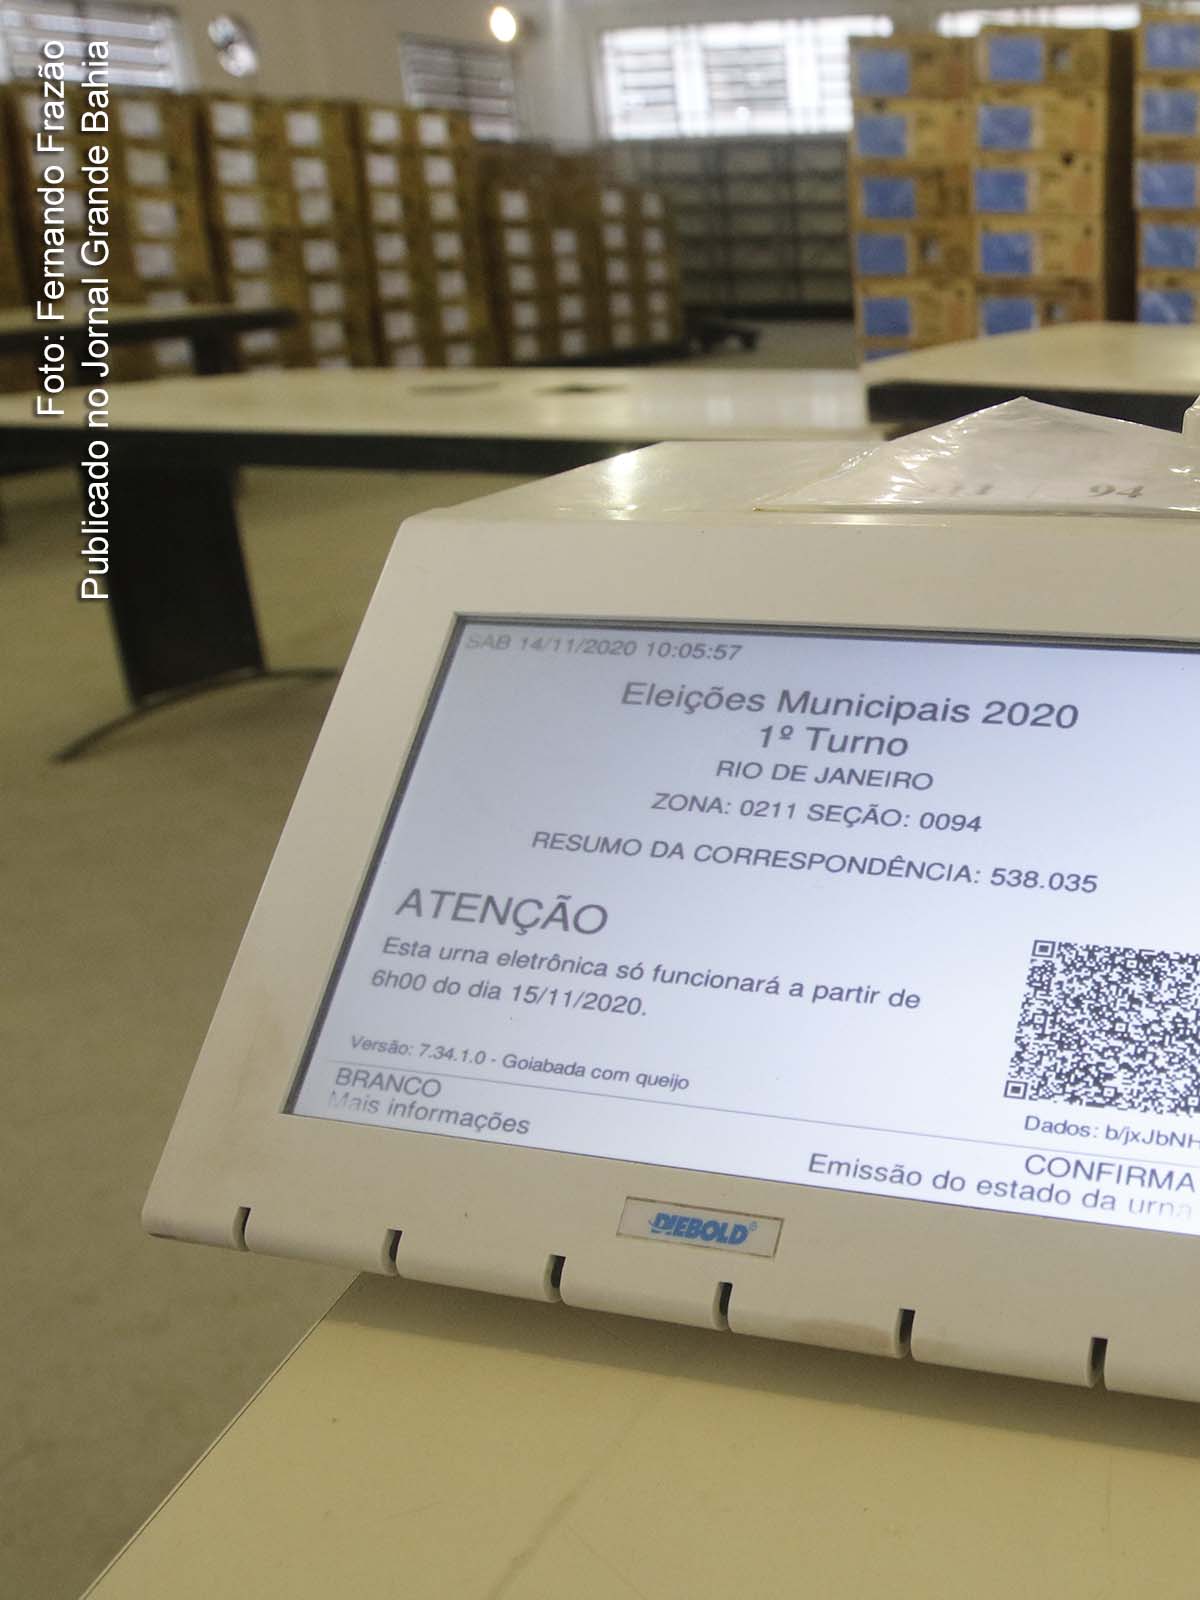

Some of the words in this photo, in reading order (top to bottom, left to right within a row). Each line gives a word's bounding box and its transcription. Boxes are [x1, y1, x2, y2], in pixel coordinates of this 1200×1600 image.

[519, 637, 638, 657] 14/11/2020
[646, 641, 743, 661] 10:05:57
[621, 681, 766, 715] Eleições
[776, 689, 970, 726] Municipais
[981, 700, 1079, 729] 2020
[760, 724, 794, 748] 1º
[805, 726, 909, 757] Turno
[715, 759, 763, 780] RIO
[771, 764, 808, 782] DE
[814, 767, 934, 791] JANEIRO
[651, 792, 730, 816] ZONA:
[740, 799, 796, 820] 0211
[806, 803, 911, 828] SEÇÃO:
[919, 812, 983, 833] 0094
[531, 831, 642, 857] RESUMO
[650, 840, 685, 860] DA
[693, 844, 981, 884] CORRESPONDÊNCIA:
[989, 867, 1098, 893] 538.035
[395, 888, 608, 936] ATENÇÃO
[371, 969, 427, 991] 6h00
[432, 975, 461, 996] do
[468, 979, 502, 1000] dia
[511, 984, 647, 1016] 15/11/2020.
[382, 936, 432, 959] Esta
[439, 948, 489, 966] urna
[496, 949, 608, 977] eletrônica
[616, 962, 644, 982] só
[652, 964, 780, 994] funcionará
[788, 981, 805, 998] a
[812, 984, 881, 1004] partir
[888, 988, 921, 1009] de
[335, 1067, 442, 1098] BRANCO
[350, 1035, 415, 1057] Versão:
[419, 1043, 487, 1065] 7.34.1.0
[502, 1053, 586, 1078] Goiabada
[590, 1066, 630, 1083] com
[635, 1072, 690, 1092] queijo
[328, 1090, 380, 1114] Mais
[386, 1097, 530, 1134] informações
[1024, 1115, 1099, 1138] Dados:
[808, 1152, 923, 1187] Emissão
[932, 1170, 966, 1192] do
[976, 1179, 1071, 1205] estado
[1082, 1188, 1116, 1211] da
[1025, 1154, 1196, 1193] CONFIRMA
